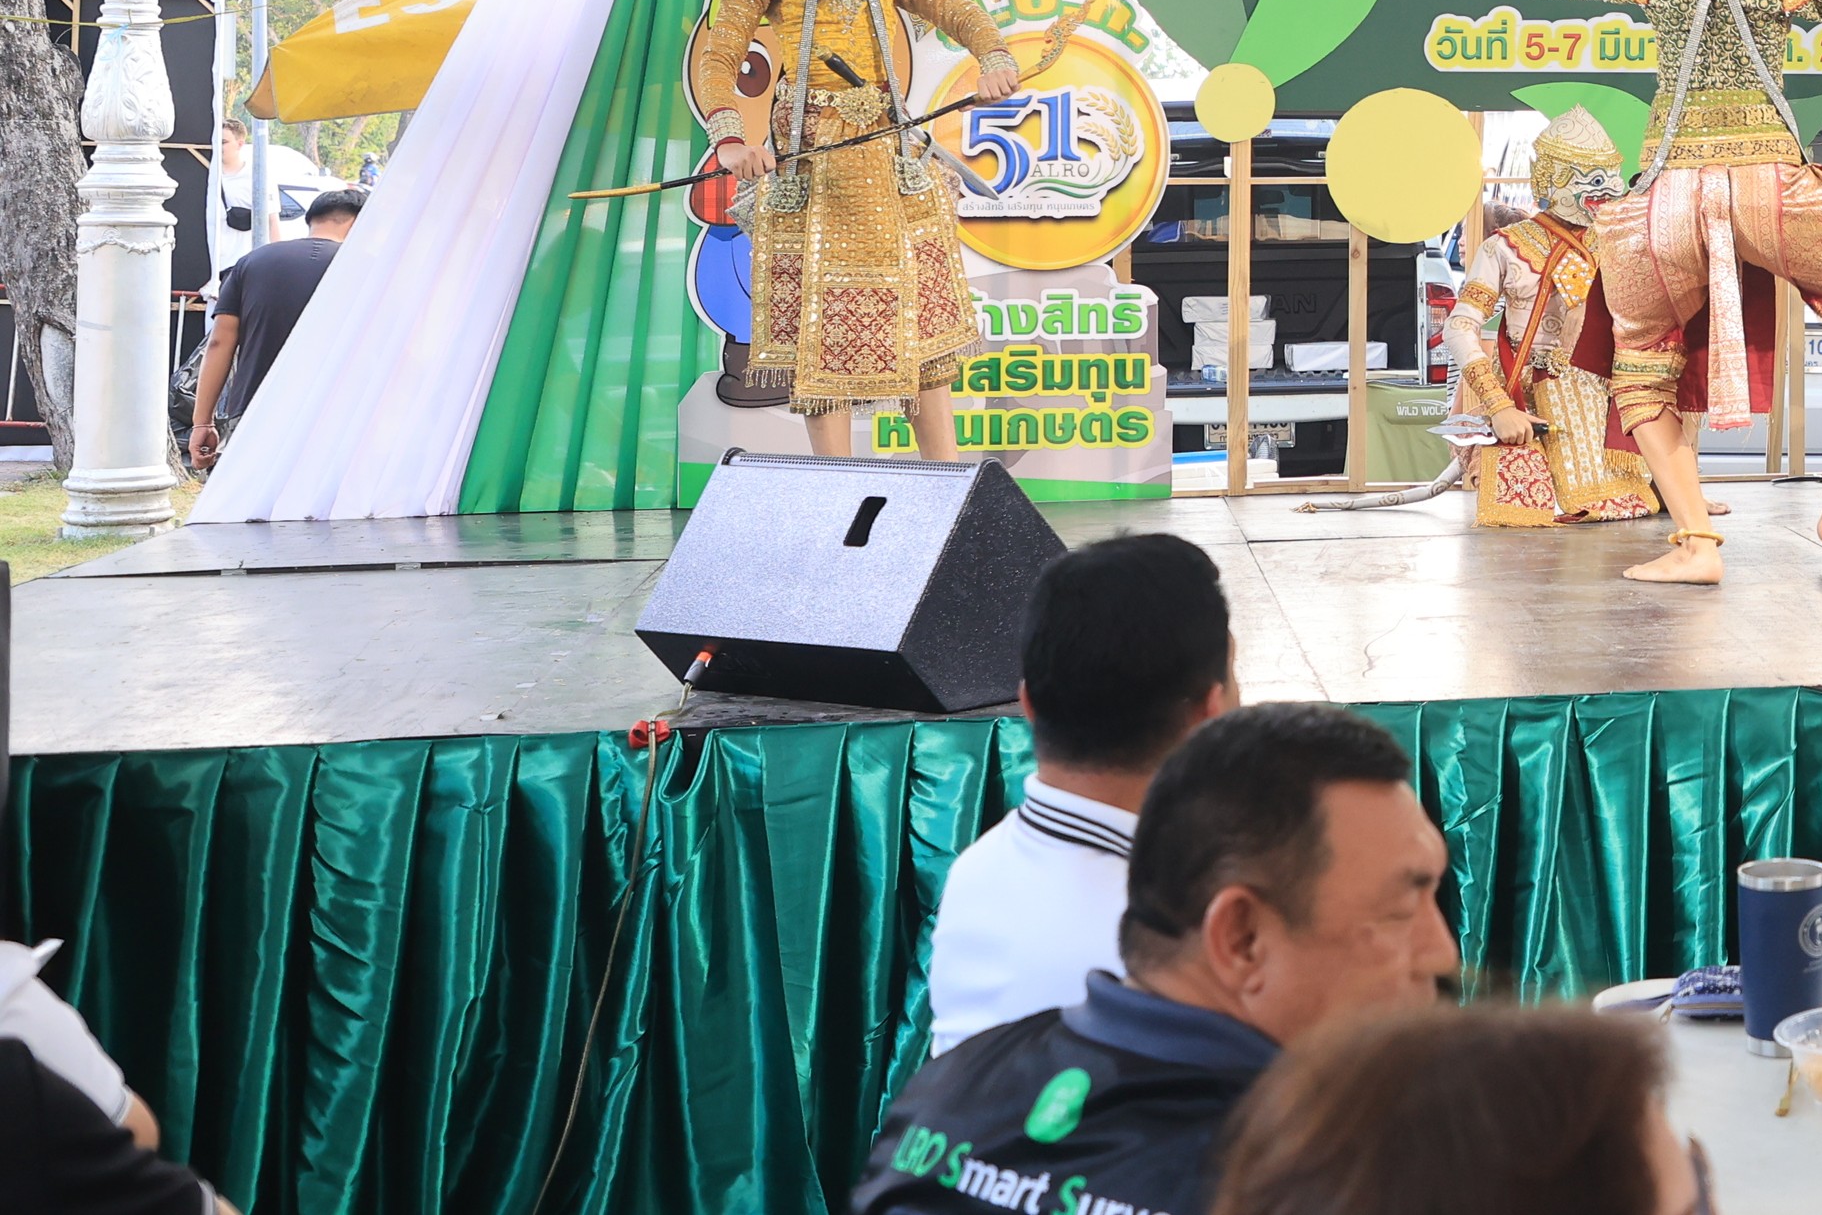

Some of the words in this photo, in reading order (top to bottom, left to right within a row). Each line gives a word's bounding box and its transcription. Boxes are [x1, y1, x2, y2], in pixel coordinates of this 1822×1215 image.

[1436, 20, 1508, 62] วันที่
[1525, 32, 1582, 62] 5-7
[967, 92, 1081, 196] 51
[1030, 162, 1090, 178] ALRO
[1421, 405, 1447, 416] WOLF
[937, 1141, 1051, 1215] Smart
